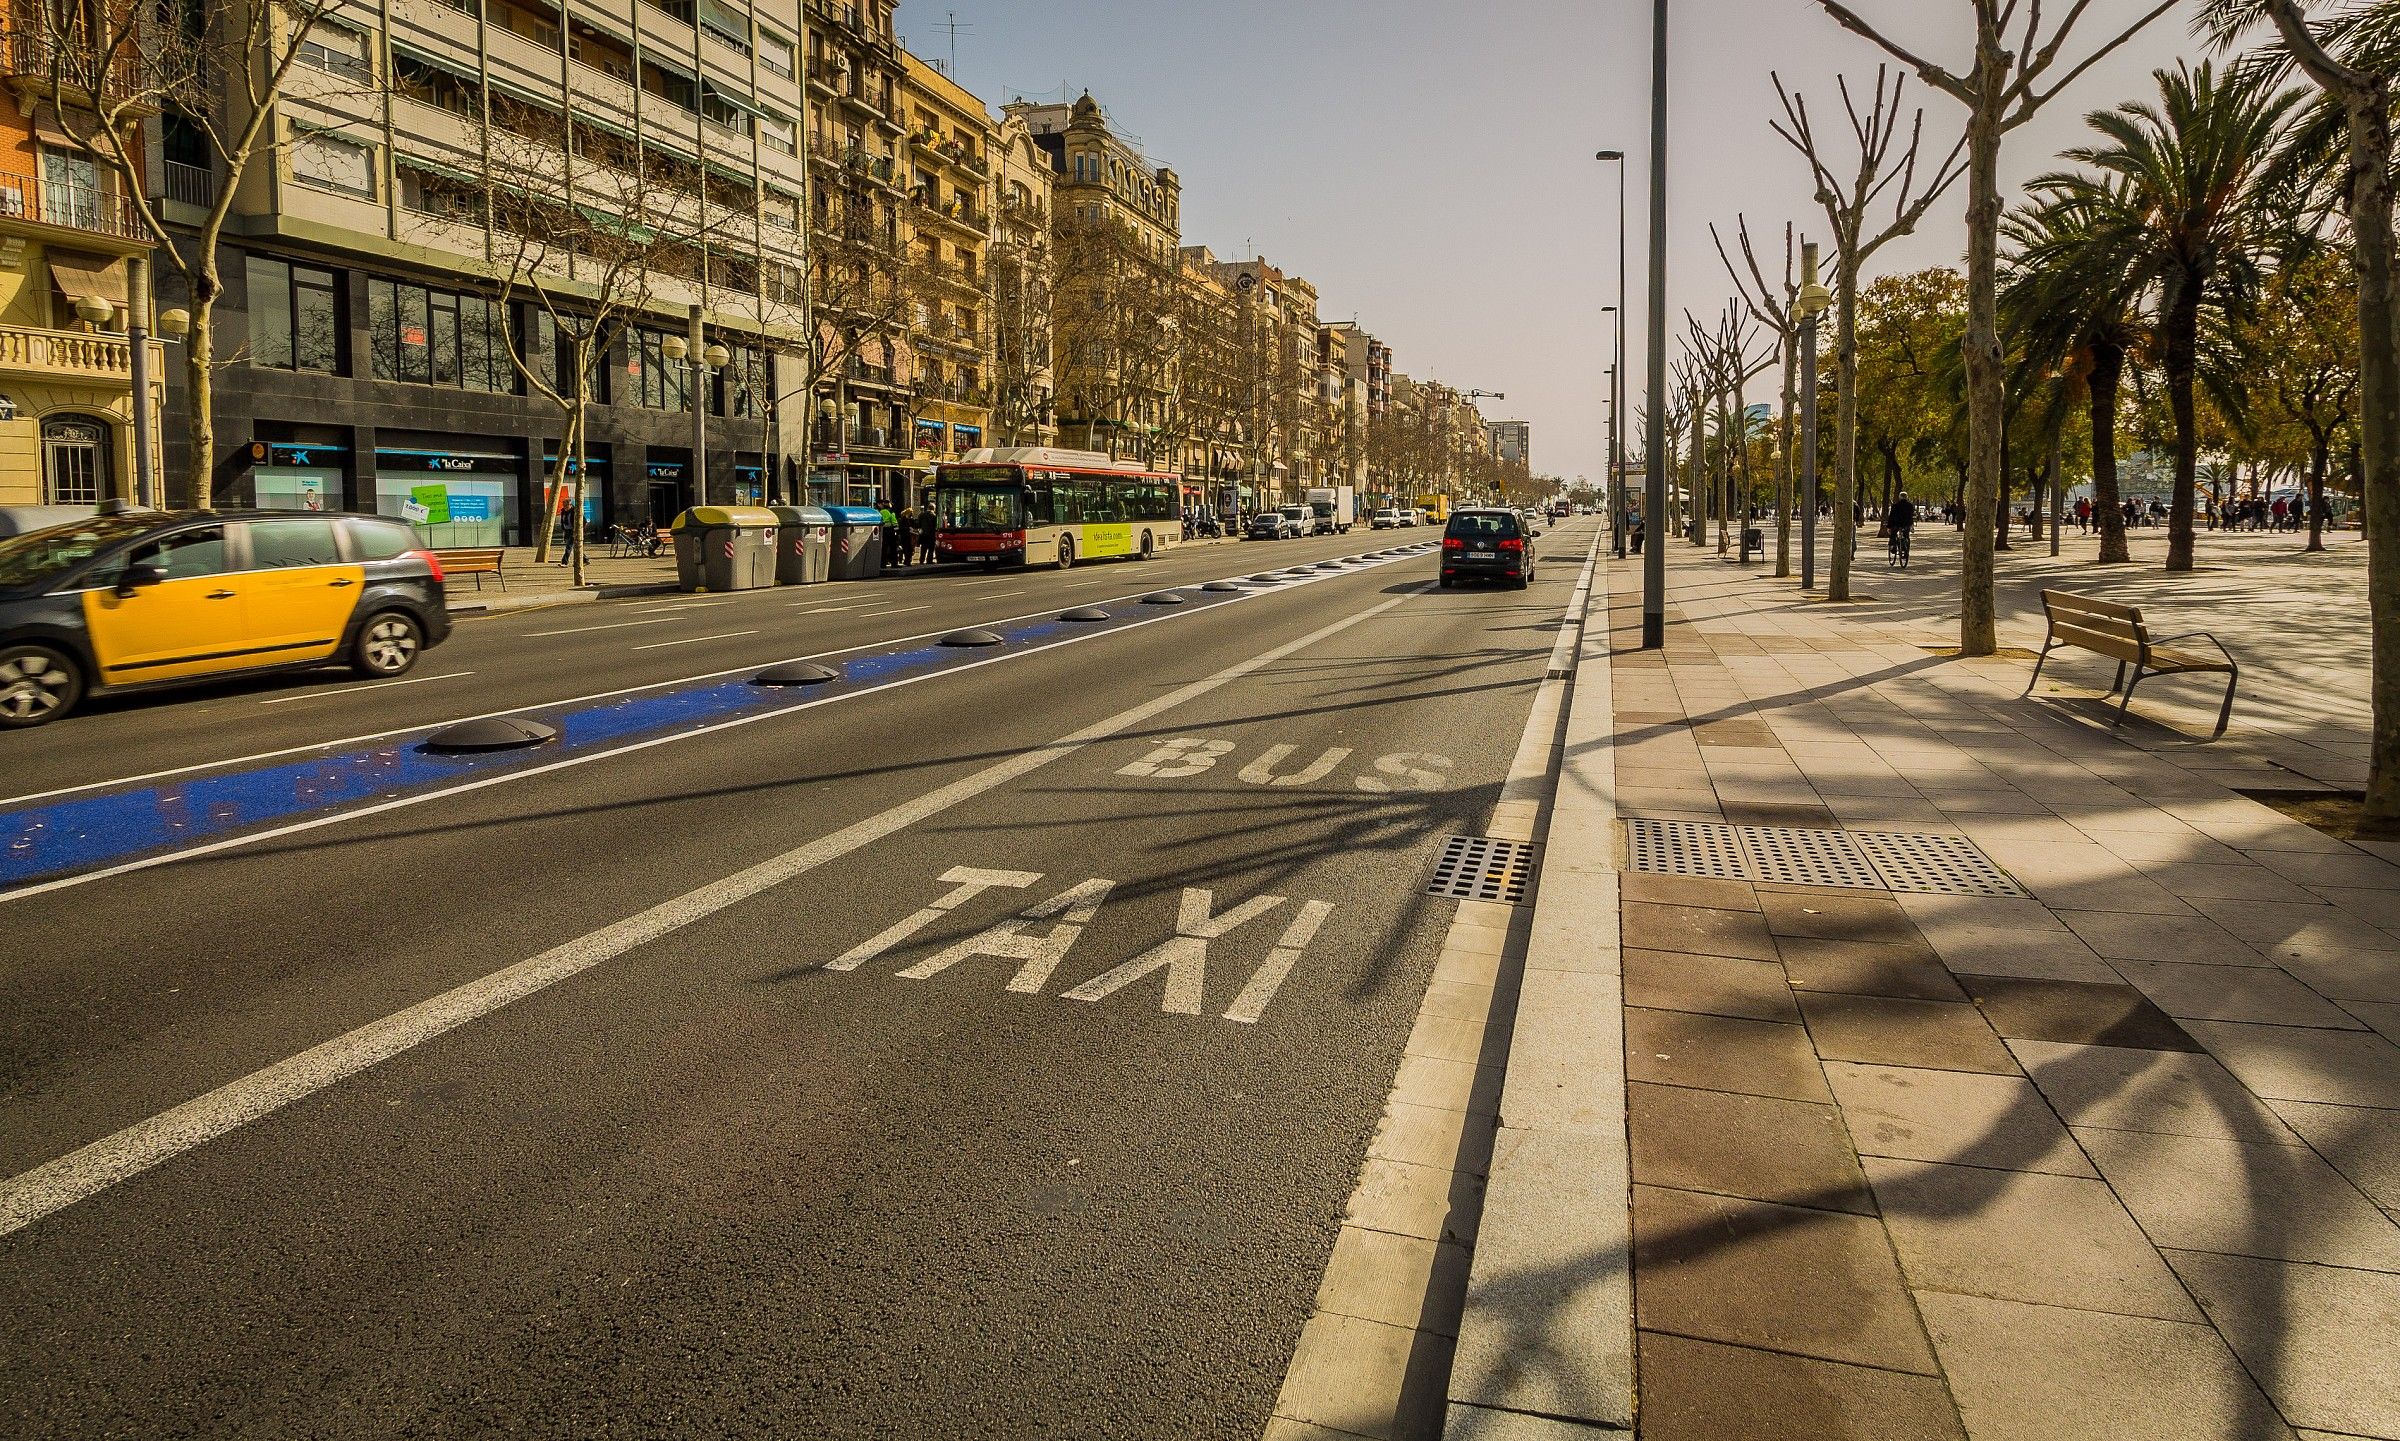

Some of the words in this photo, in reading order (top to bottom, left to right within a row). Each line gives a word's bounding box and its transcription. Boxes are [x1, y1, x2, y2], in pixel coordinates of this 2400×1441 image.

[1093, 531, 1122, 541] idealista.com
[1114, 737, 1454, 794] BUS
[822, 865, 1336, 1025] TAXI
